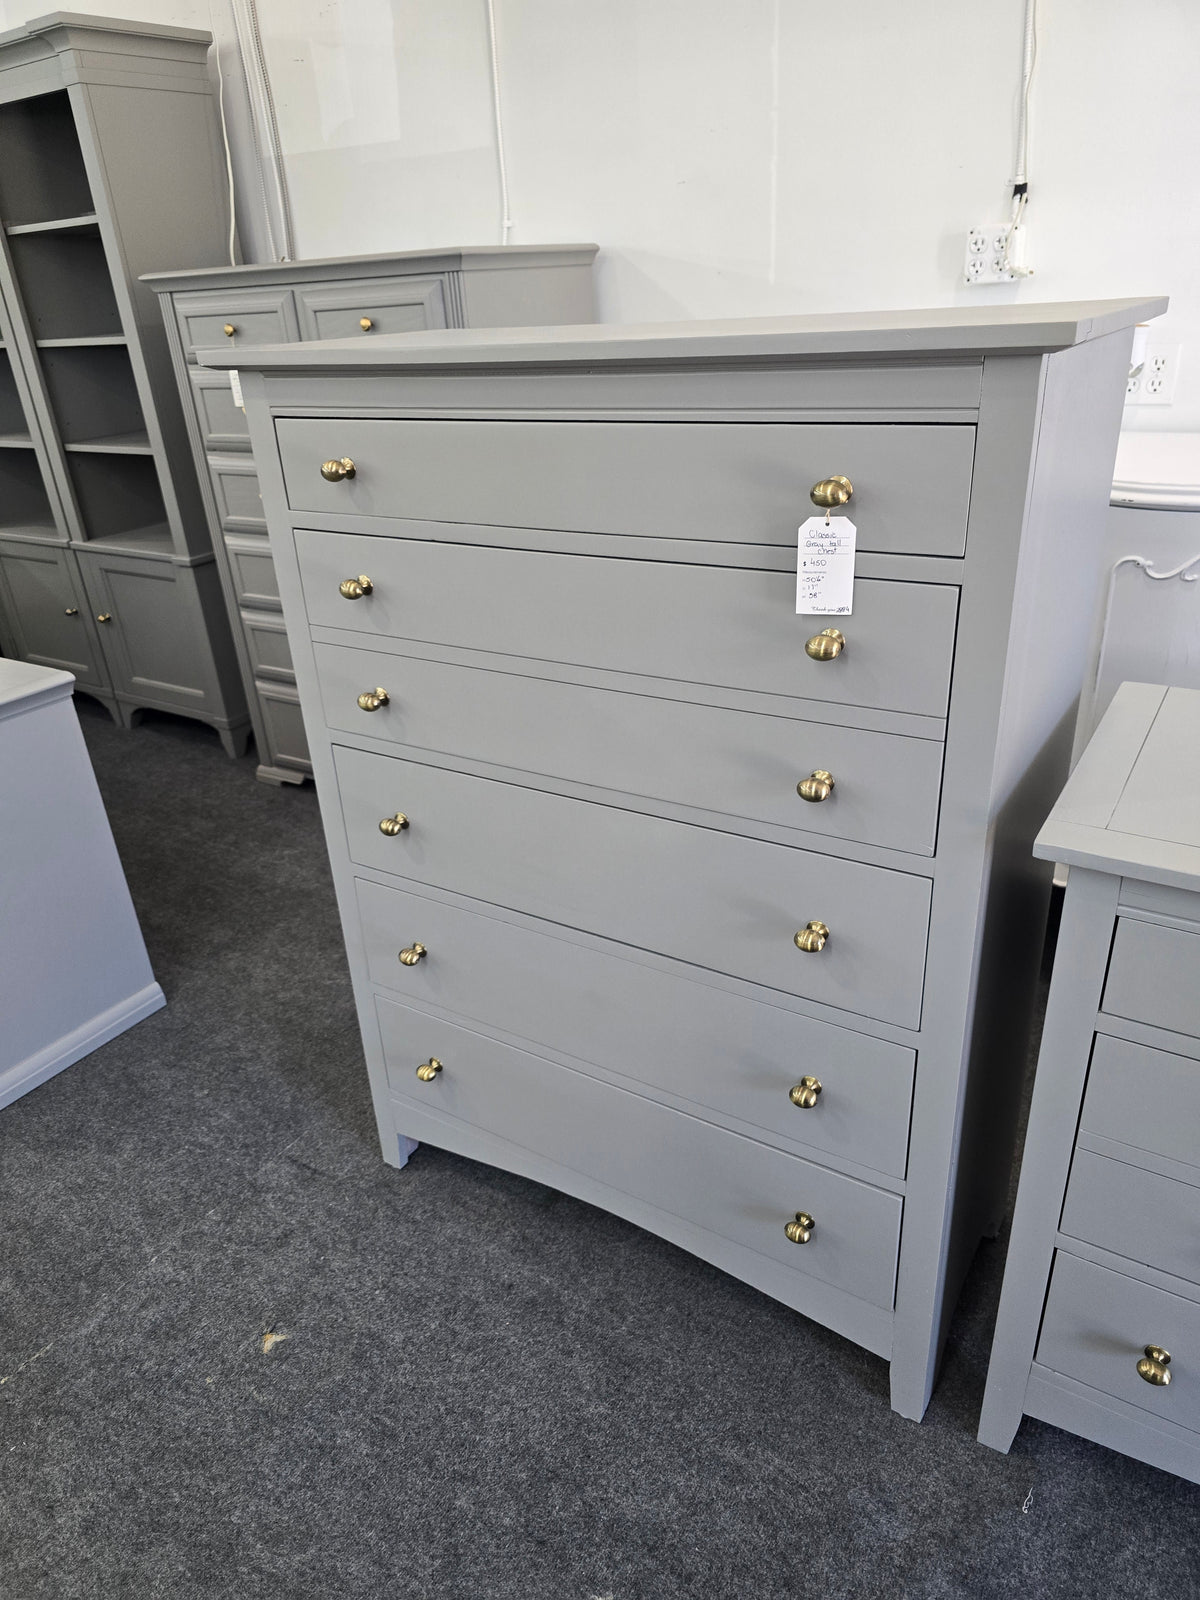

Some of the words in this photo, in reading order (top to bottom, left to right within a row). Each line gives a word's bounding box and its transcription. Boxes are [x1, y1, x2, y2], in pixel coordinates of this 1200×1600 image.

[808, 529, 837, 539] Classic
[805, 541, 824, 549] Gray
[810, 558, 827, 567] 450
